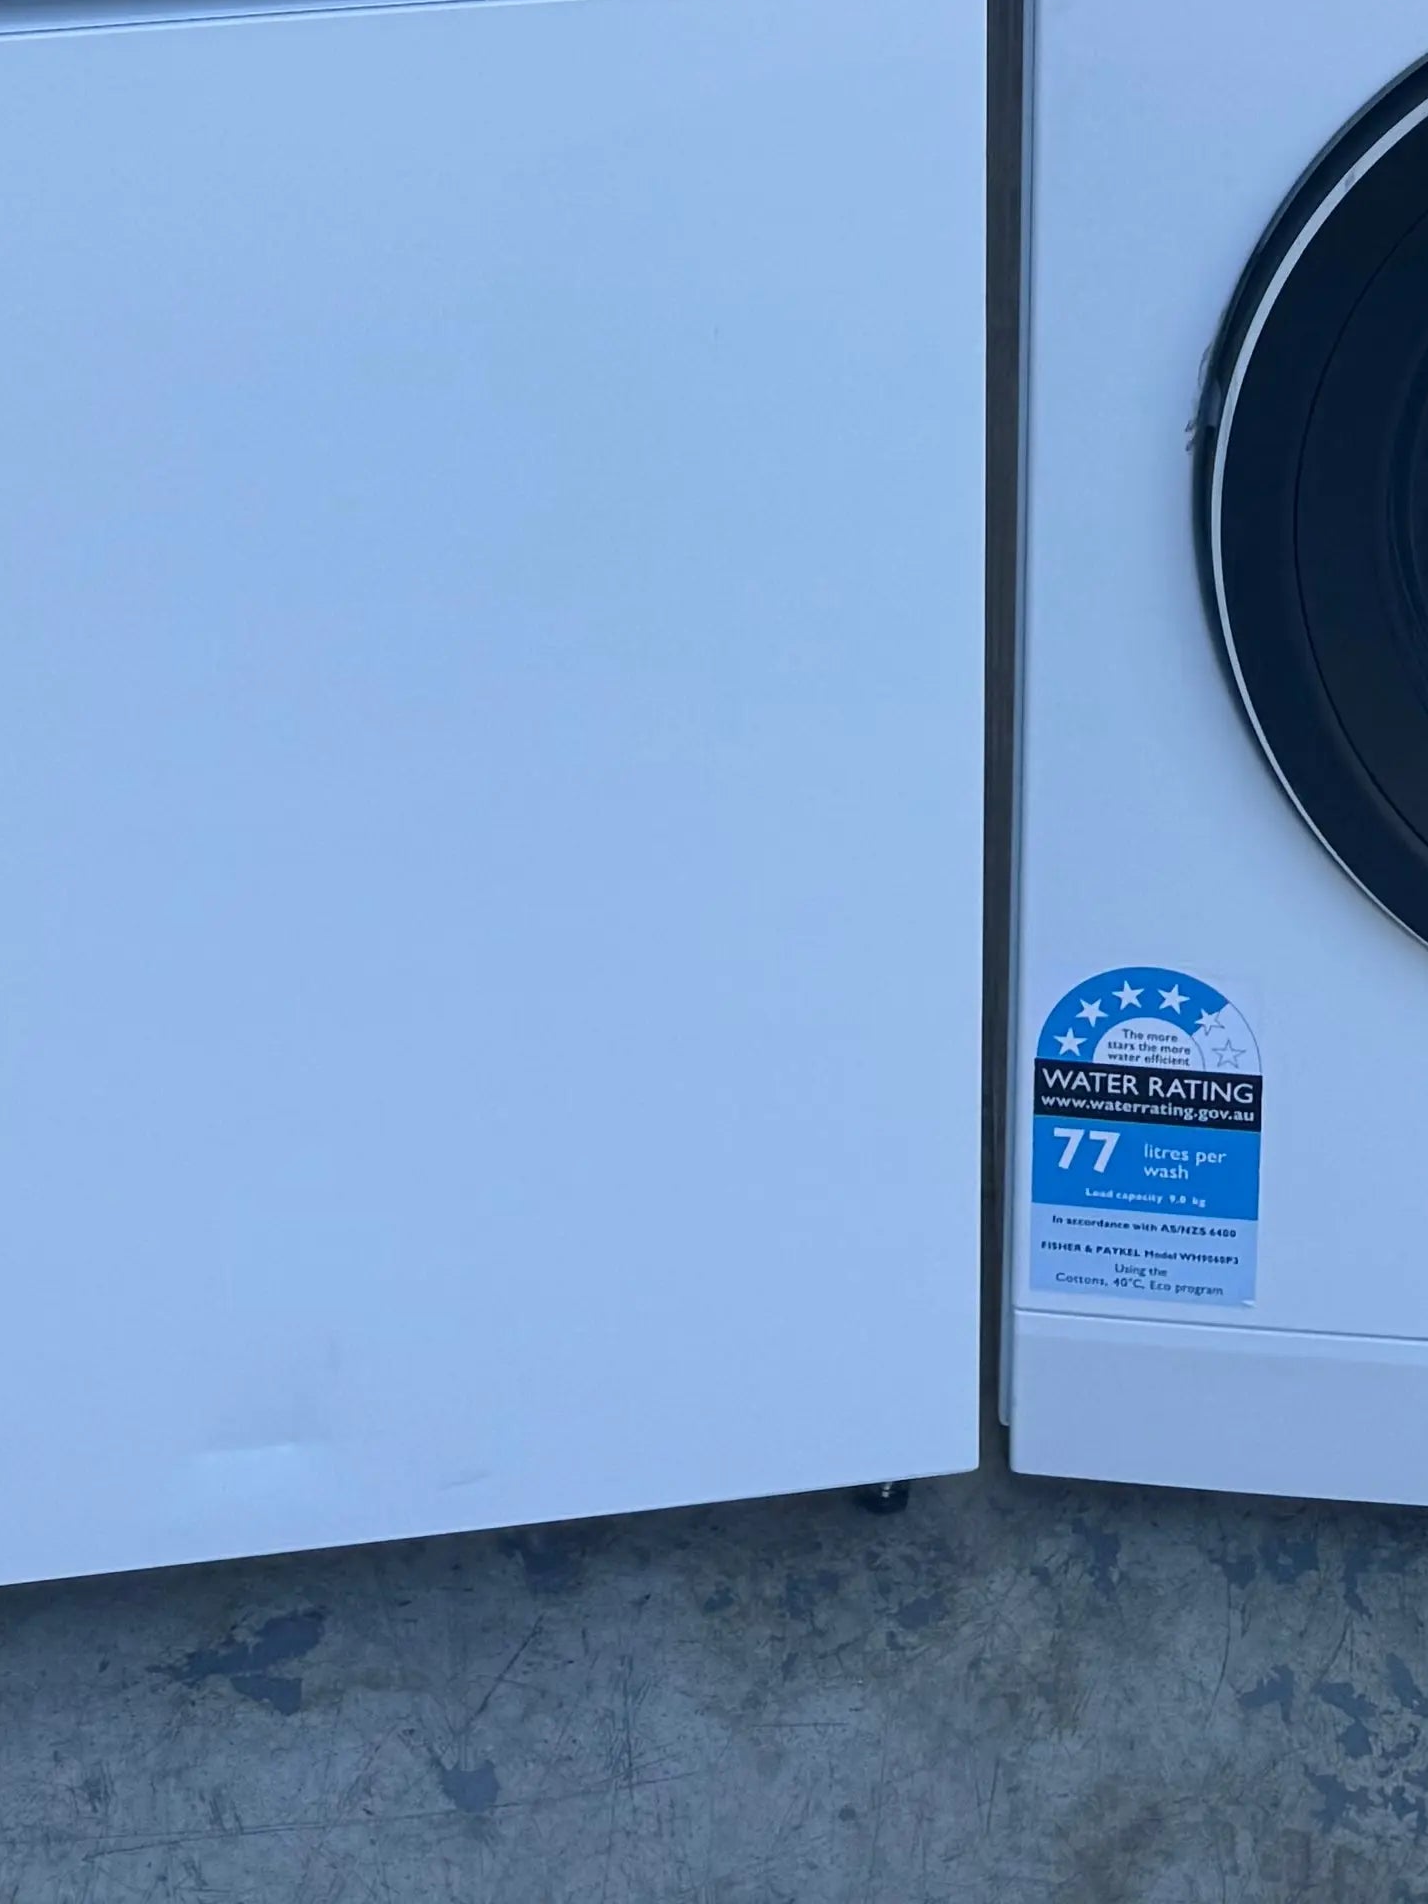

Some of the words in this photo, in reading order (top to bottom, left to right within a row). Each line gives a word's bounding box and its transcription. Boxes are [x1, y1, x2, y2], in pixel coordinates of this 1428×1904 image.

[1122, 1029, 1143, 1040] The
[1147, 1034, 1178, 1042] more
[1139, 1042, 1157, 1051] the
[1160, 1046, 1190, 1054] more
[1108, 1054, 1141, 1062] water
[1145, 1054, 1190, 1066] efficient
[1042, 1068, 1139, 1095] WATER
[1148, 1077, 1254, 1104] RATING
[1041, 1095, 1254, 1122] www.waterrating.gov.au
[1053, 1128, 1121, 1173] 77
[1144, 1144, 1189, 1161] litres
[1196, 1152, 1226, 1166] per
[1144, 1164, 1188, 1179] wash
[1041, 1241, 1081, 1251] FISHER
[1085, 1245, 1092, 1253] &
[1096, 1246, 1140, 1256] PAYKEL
[1056, 1272, 1108, 1286] Cottons,
[1150, 1280, 1171, 1291] Eco
[1175, 1285, 1223, 1296] program
